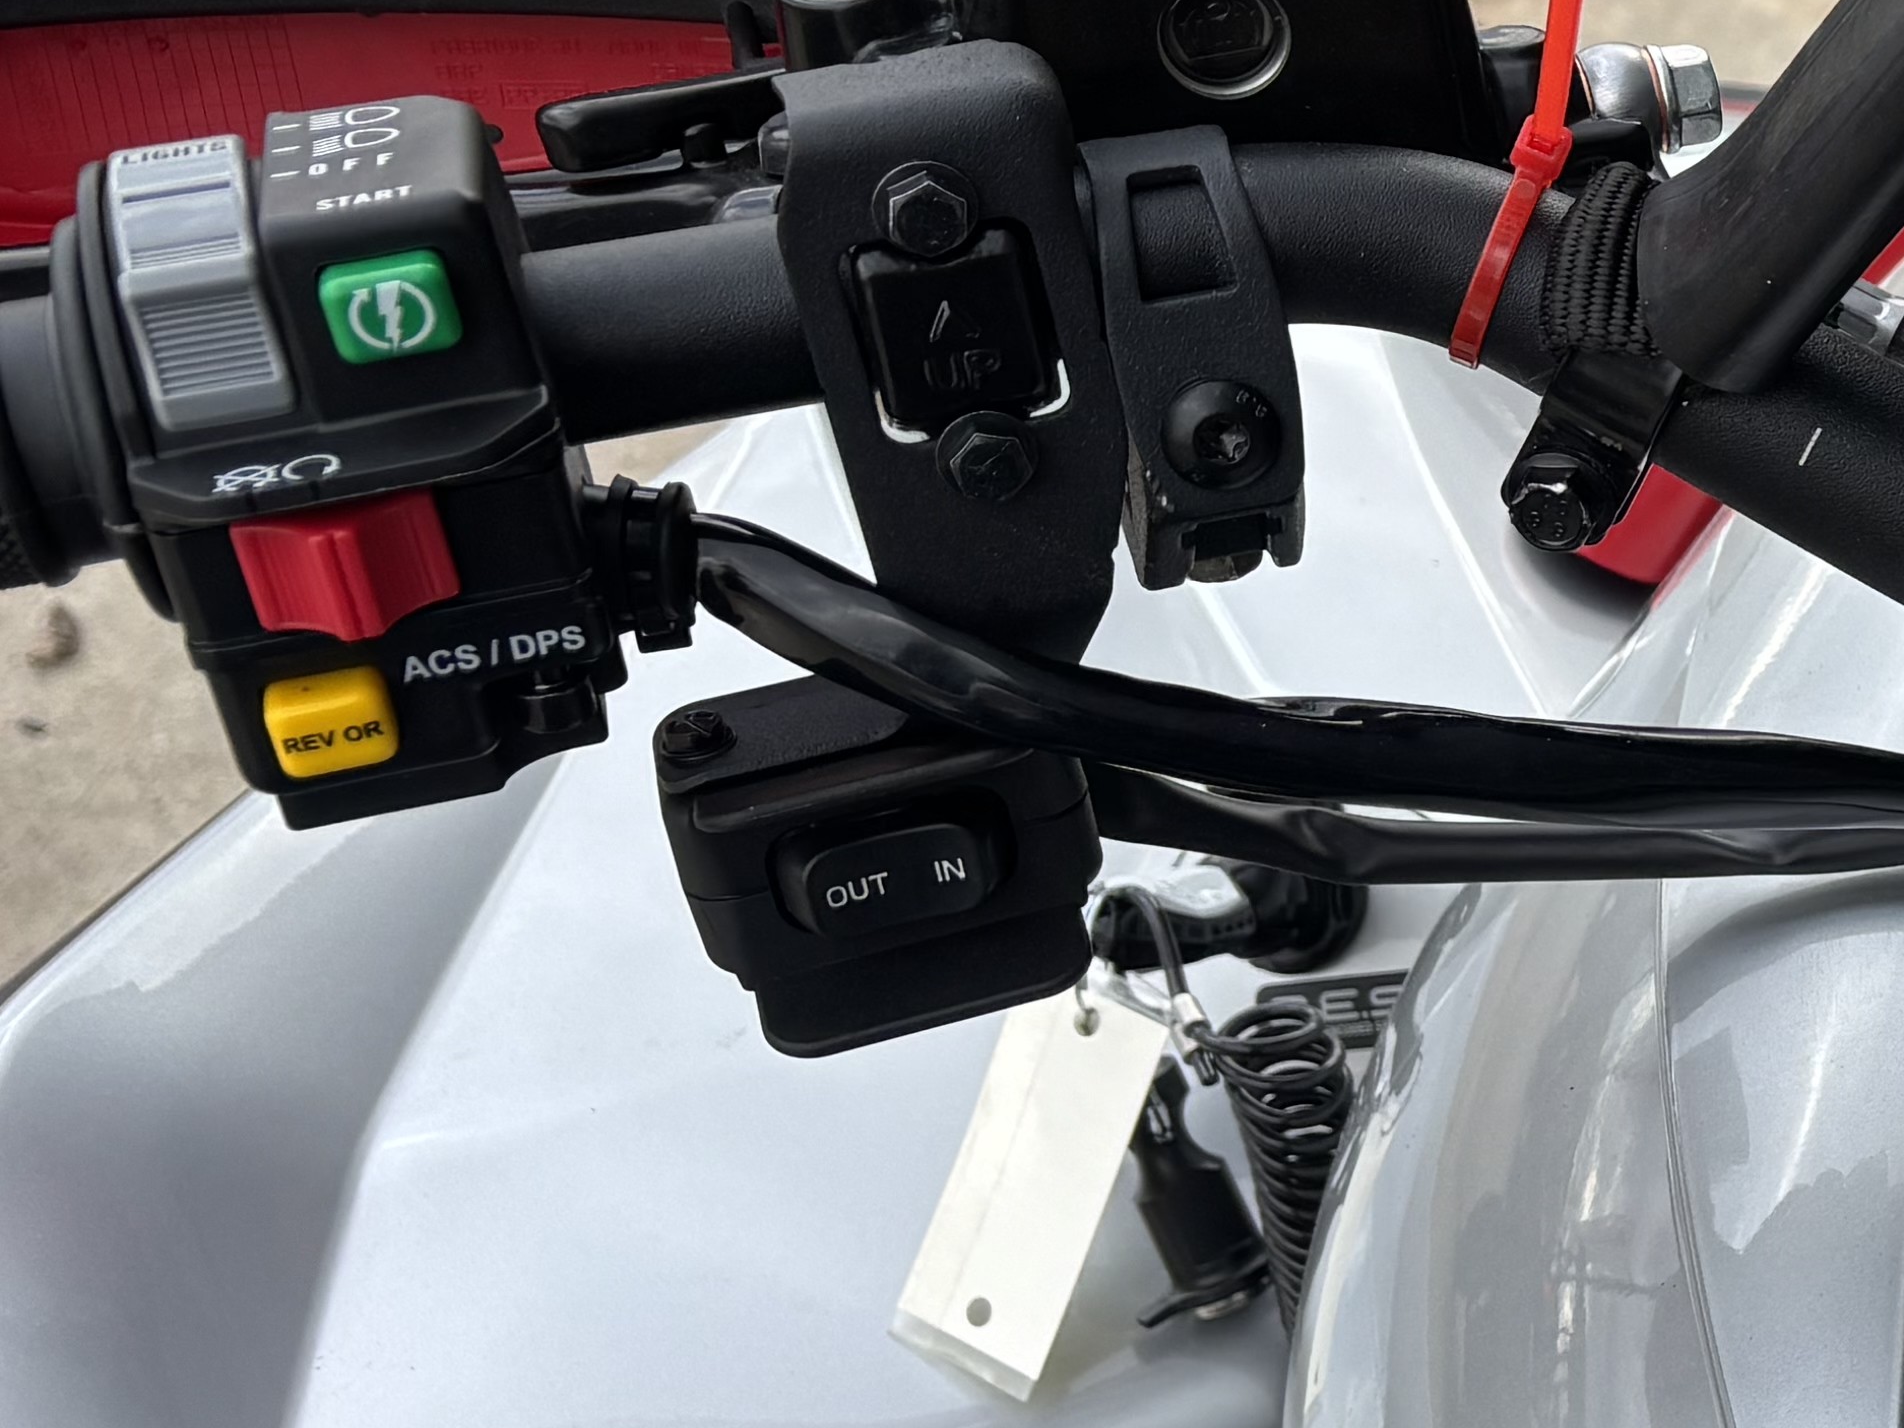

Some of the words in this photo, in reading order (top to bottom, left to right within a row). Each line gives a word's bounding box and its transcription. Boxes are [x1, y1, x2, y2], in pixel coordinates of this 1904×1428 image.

[121, 140, 228, 165] LIGHTS
[316, 184, 412, 211] START
[924, 349, 1000, 390] UP
[402, 645, 481, 682] ACS
[513, 625, 587, 662] DPS
[283, 727, 335, 754] REV
[344, 720, 384, 744] OR
[826, 872, 888, 908] OUT
[934, 857, 966, 883] IN
